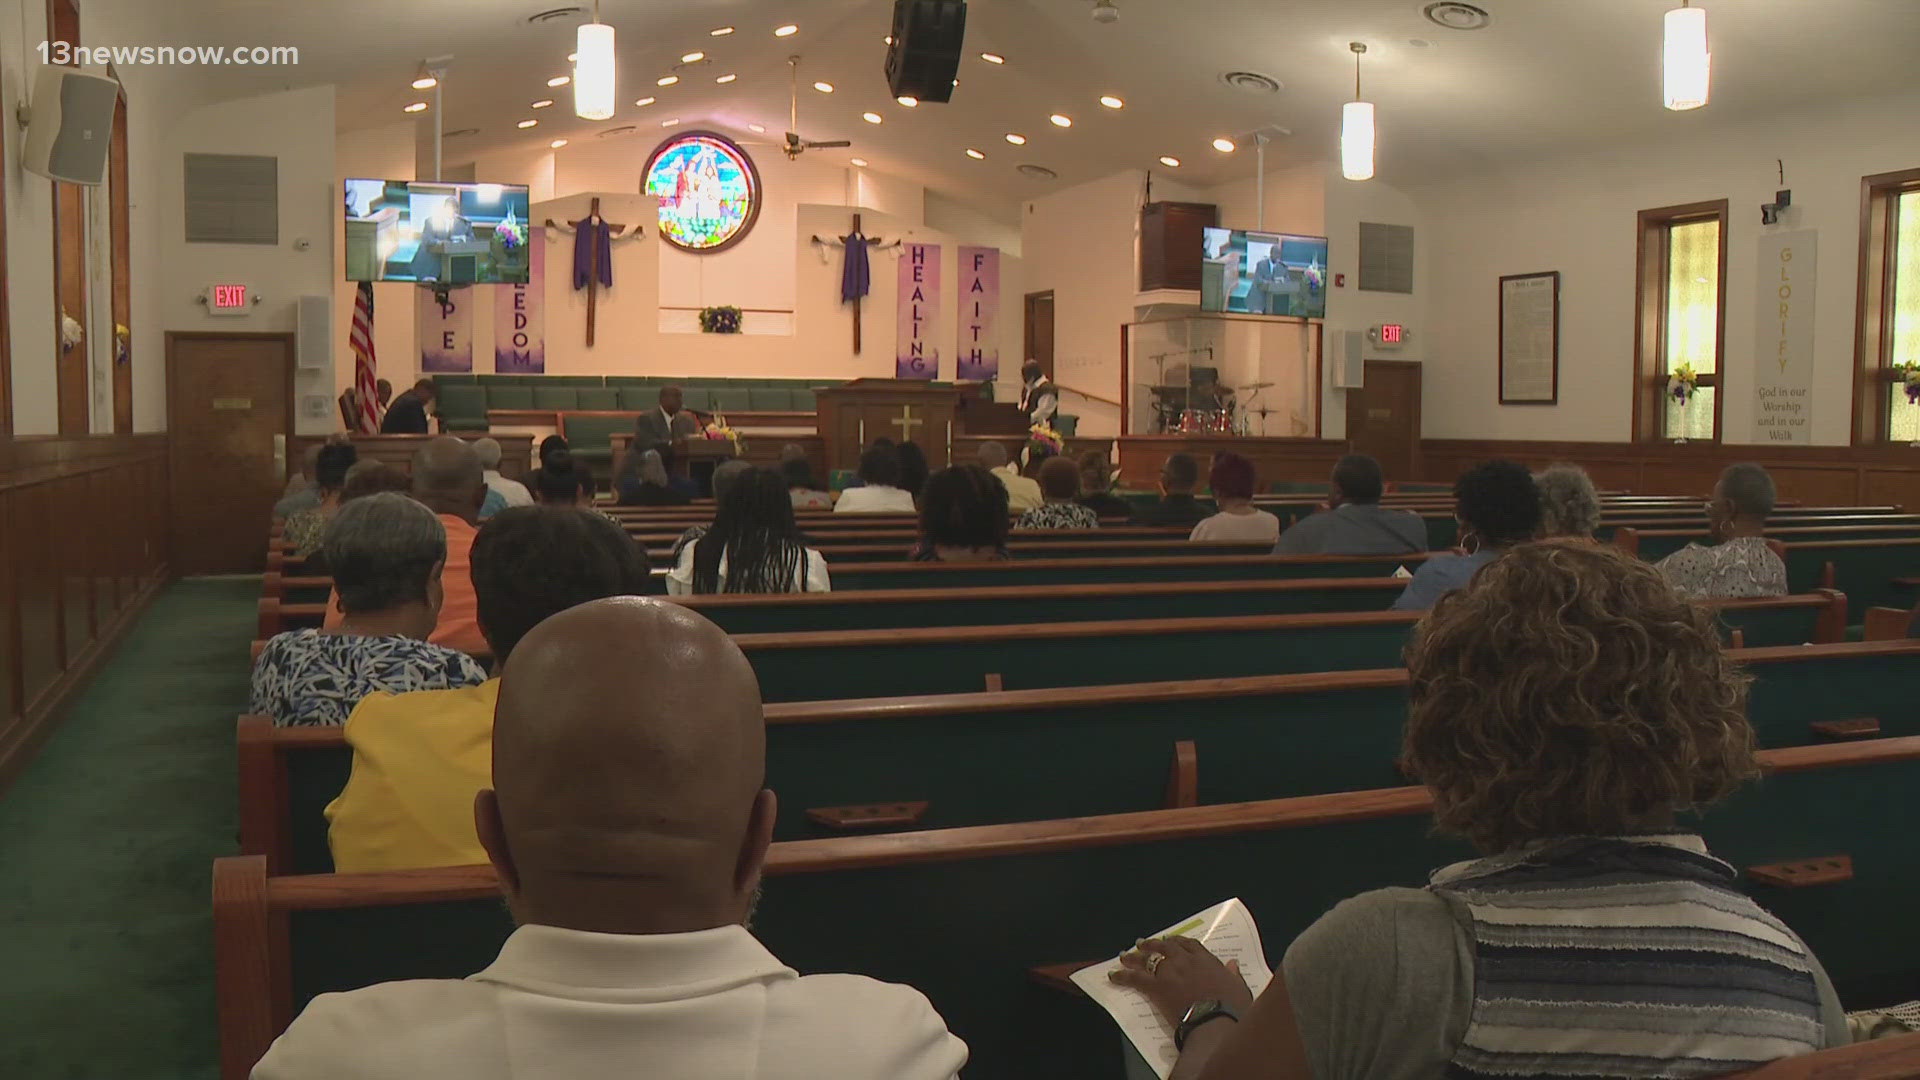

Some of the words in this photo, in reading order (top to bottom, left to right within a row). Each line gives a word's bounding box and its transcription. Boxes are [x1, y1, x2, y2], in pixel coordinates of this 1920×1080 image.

[215, 285, 246, 307] EXIT
[911, 246, 925, 373] HEALING
[971, 253, 984, 365] FAITH
[1778, 248, 1793, 375] GLORIFY
[1382, 325, 1402, 342] EXIT
[1758, 387, 1776, 400] God
[1779, 388, 1788, 396] in
[1763, 402, 1801, 414] Worship
[1757, 416, 1775, 426] and
[1777, 416, 1787, 426] in
[1789, 418, 1806, 426] our
[1769, 430, 1792, 440] Walk
